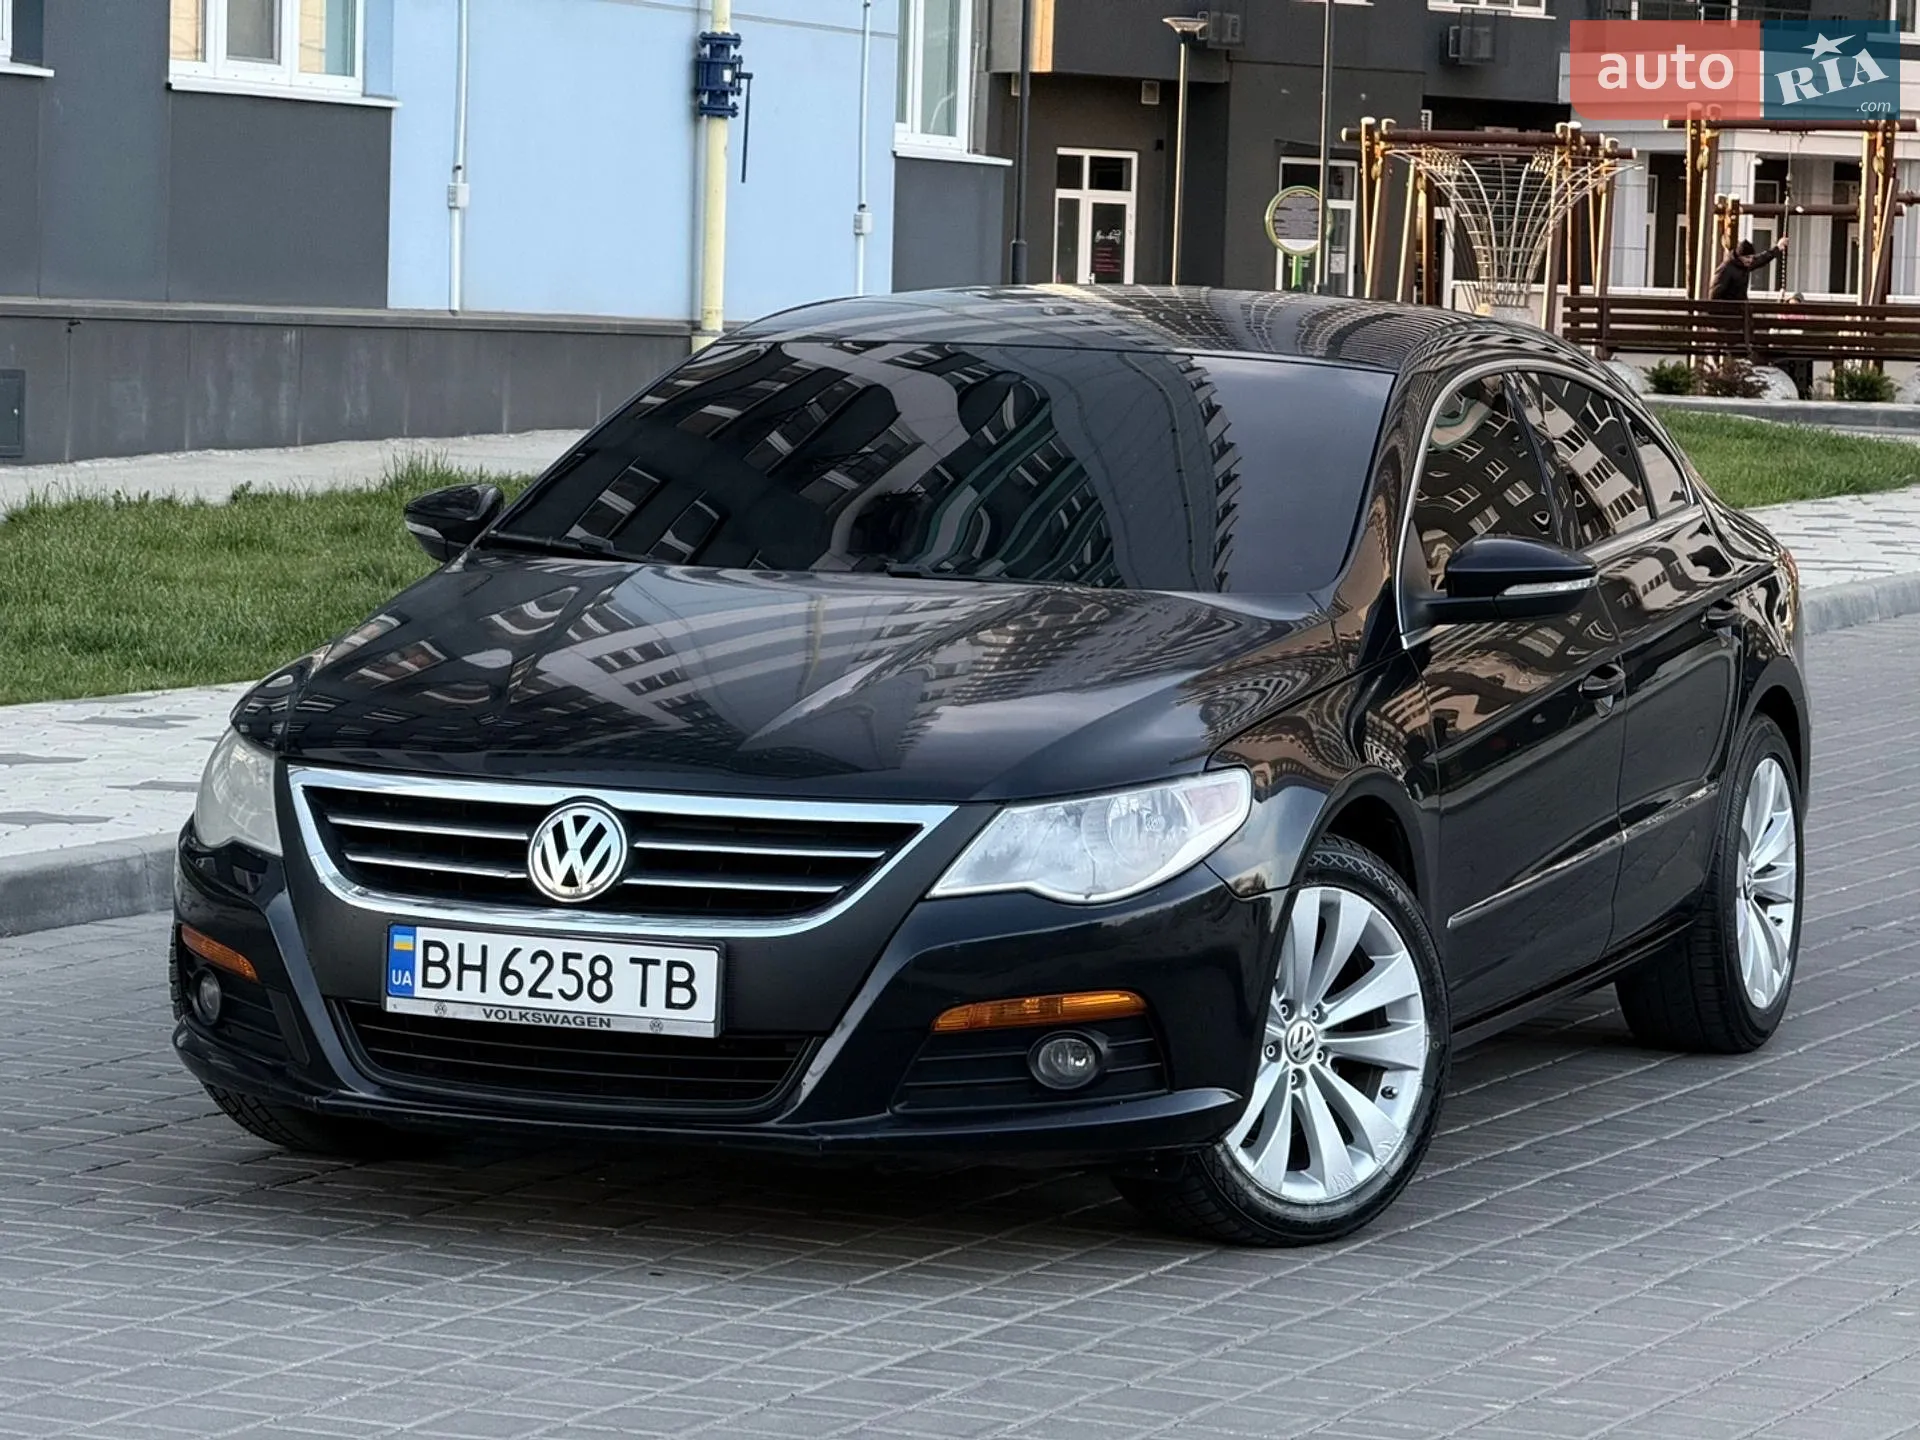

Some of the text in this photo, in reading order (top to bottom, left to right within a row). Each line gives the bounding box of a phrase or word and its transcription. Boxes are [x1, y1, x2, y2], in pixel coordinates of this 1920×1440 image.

[391, 970, 413, 987] UA
[420, 939, 699, 1011] BH 6258 TB
[482, 1007, 612, 1029] VOLKSWAGEN
